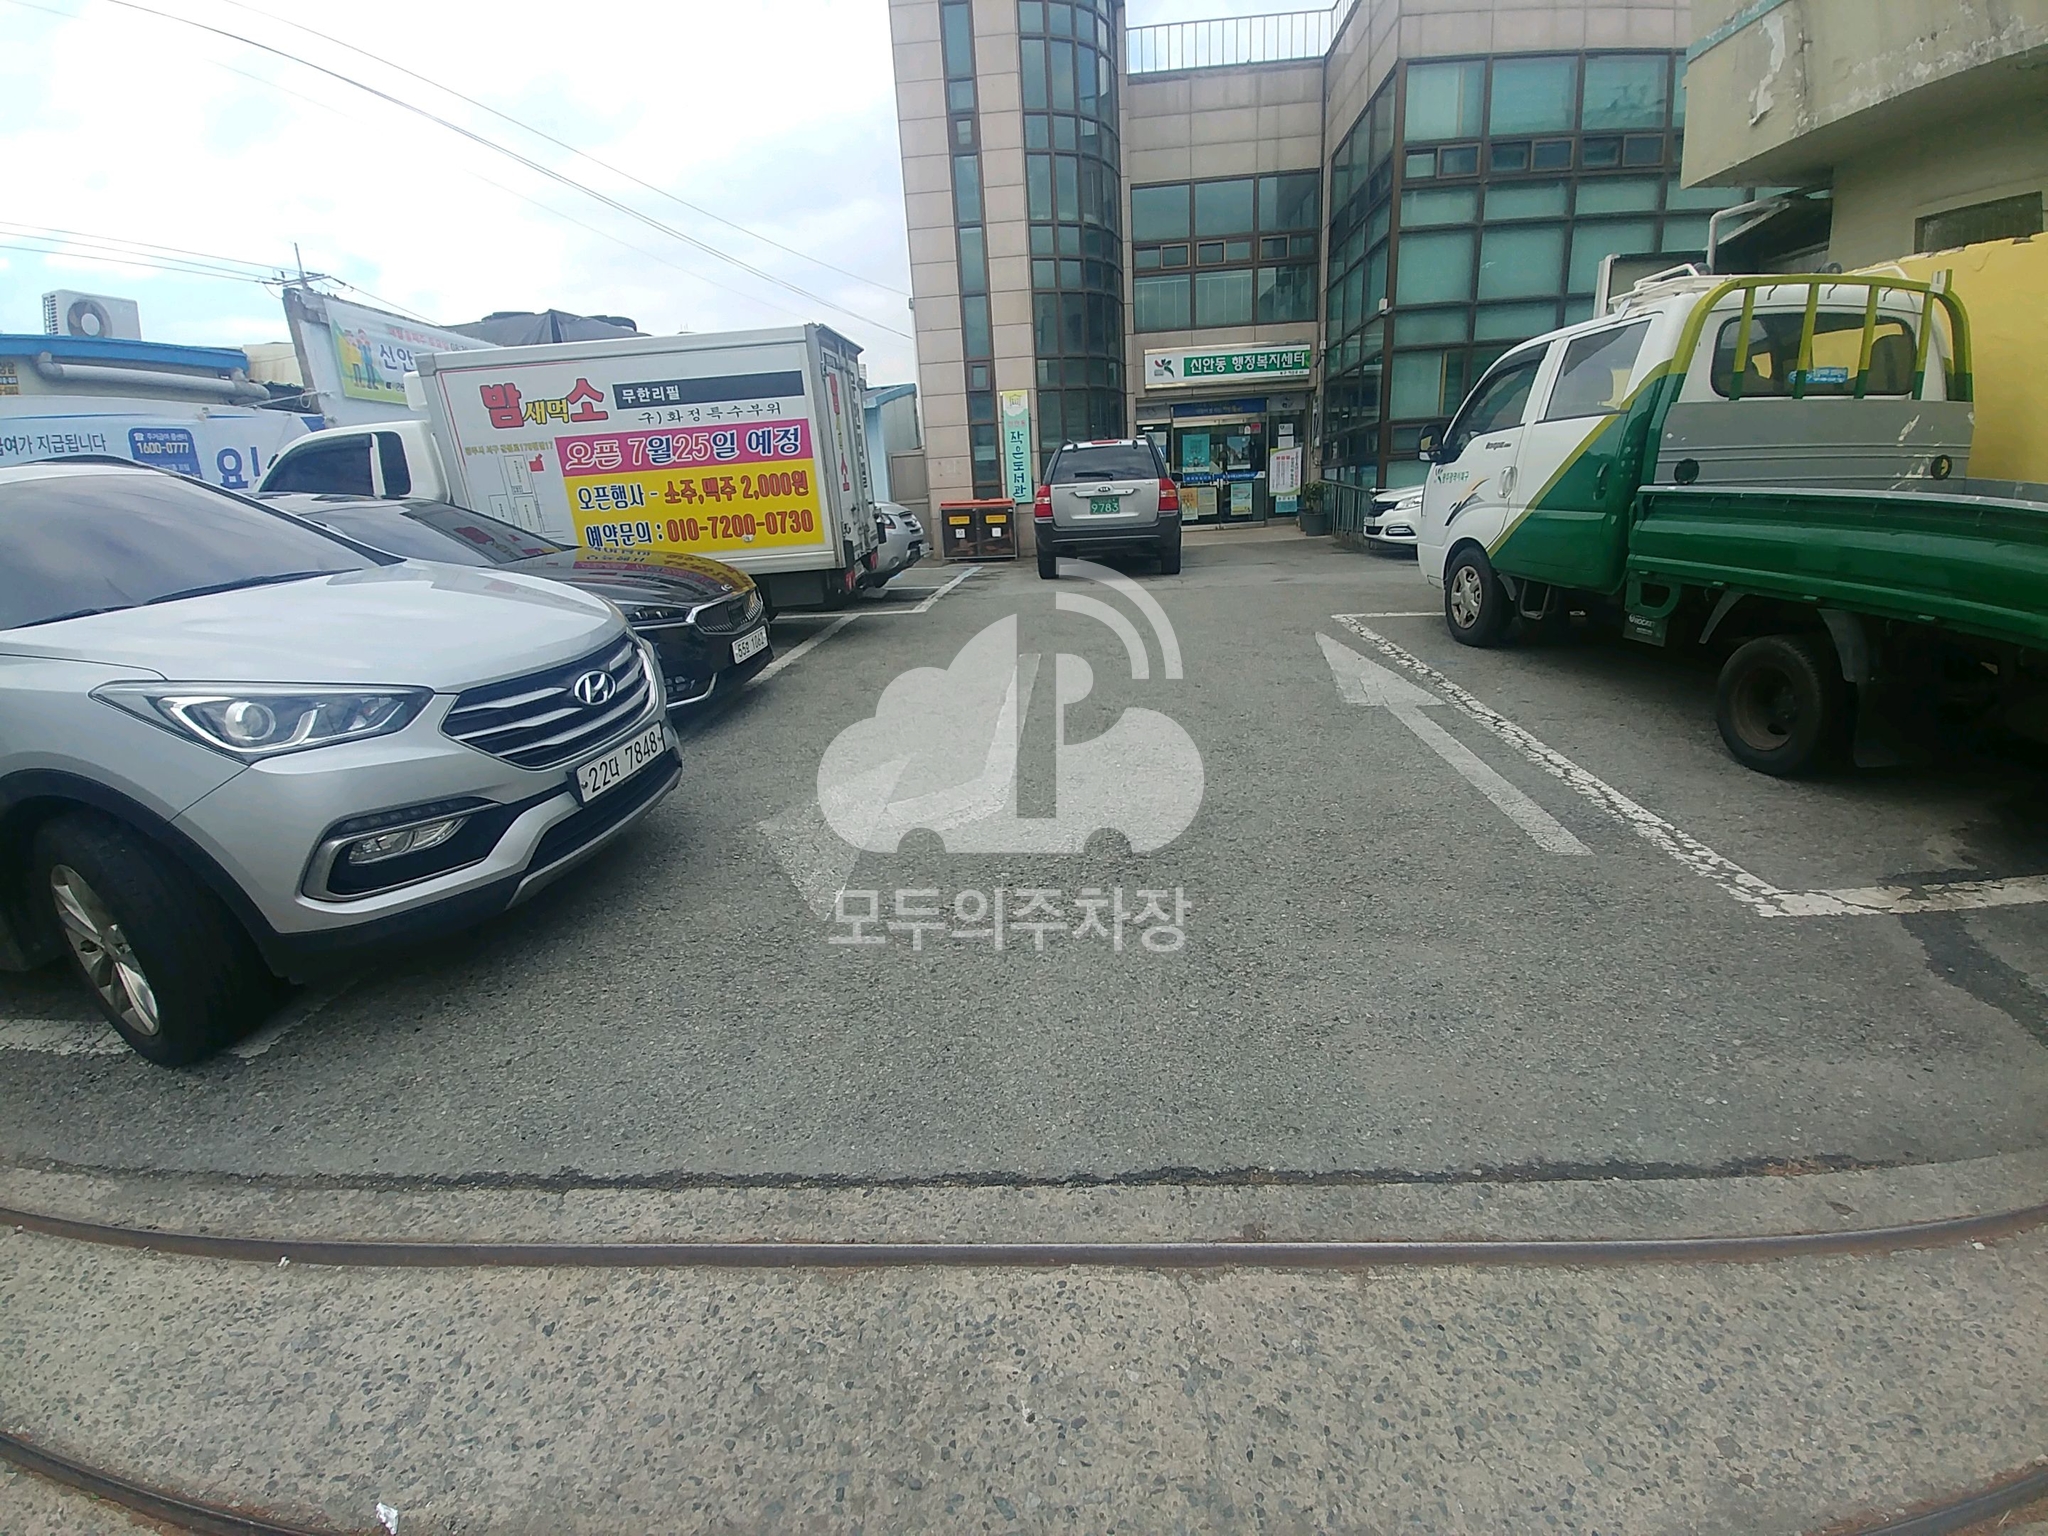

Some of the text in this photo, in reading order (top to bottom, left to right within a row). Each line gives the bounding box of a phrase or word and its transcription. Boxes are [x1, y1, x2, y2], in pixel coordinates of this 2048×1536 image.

[1190, 351, 1305, 374] 신안동 행정복지센터
[479, 378, 609, 429] 밤새먹소
[621, 385, 681, 404] 무한리필
[36, 433, 107, 453] 지급됩니다
[137, 442, 189, 454] 1600-0777
[566, 424, 801, 470] 오픈 7월25일 예정
[1010, 430, 1027, 498] 작은도서관
[577, 484, 645, 511] 오픈행사
[664, 476, 737, 505] 소주,맥주
[740, 470, 809, 500] 2,000원
[1091, 502, 1119, 513] 9783
[584, 520, 652, 548] 예약문의
[665, 508, 814, 544] 010-7200-0730
[624, 731, 658, 770] 7848
